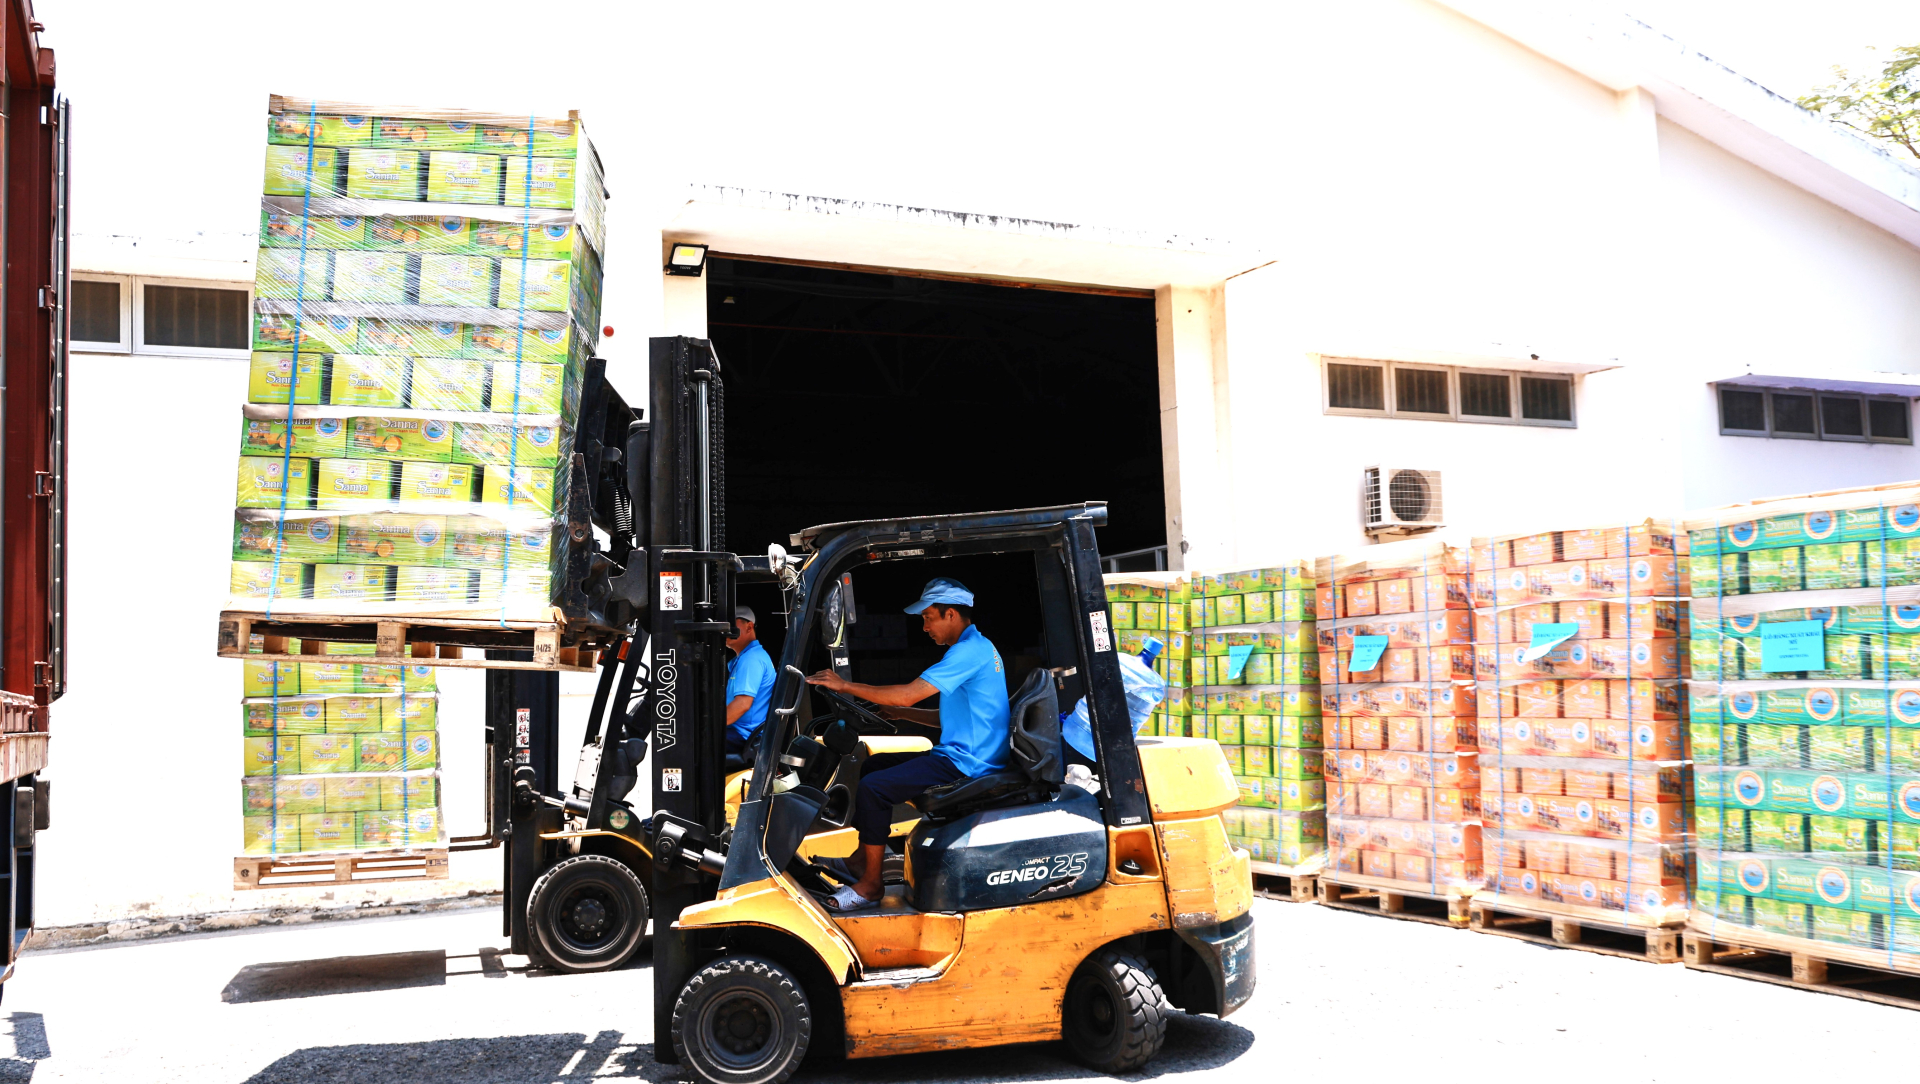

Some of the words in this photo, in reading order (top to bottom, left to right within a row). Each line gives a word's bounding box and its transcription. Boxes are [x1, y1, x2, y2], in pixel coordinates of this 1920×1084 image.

[380, 416, 418, 429] Sanna
[255, 476, 289, 489] Sann
[334, 478, 368, 492] Sanna
[417, 481, 452, 495] Sanna
[500, 484, 534, 498] Snna
[372, 520, 410, 534] Sanna
[1870, 552, 1902, 564] Snna
[1604, 564, 1630, 576] Sann
[1490, 650, 1512, 660] Snna
[656, 649, 677, 752] TOYOTA
[395, 708, 421, 718] Snna
[1491, 722, 1514, 733] Snna
[1608, 725, 1632, 738] Sann
[1876, 738, 1908, 750] Snna
[1772, 778, 1808, 796] Sanna
[1494, 797, 1517, 808] Snna
[1611, 806, 1638, 818] Sana
[382, 816, 408, 826] Sann
[1698, 816, 1721, 828] Sann
[1880, 832, 1914, 846] Snna
[1022, 857, 1050, 866] OMPACT
[986, 866, 1049, 886] GENEO
[1050, 852, 1088, 879] 25
[1777, 868, 1814, 887] Sanna
